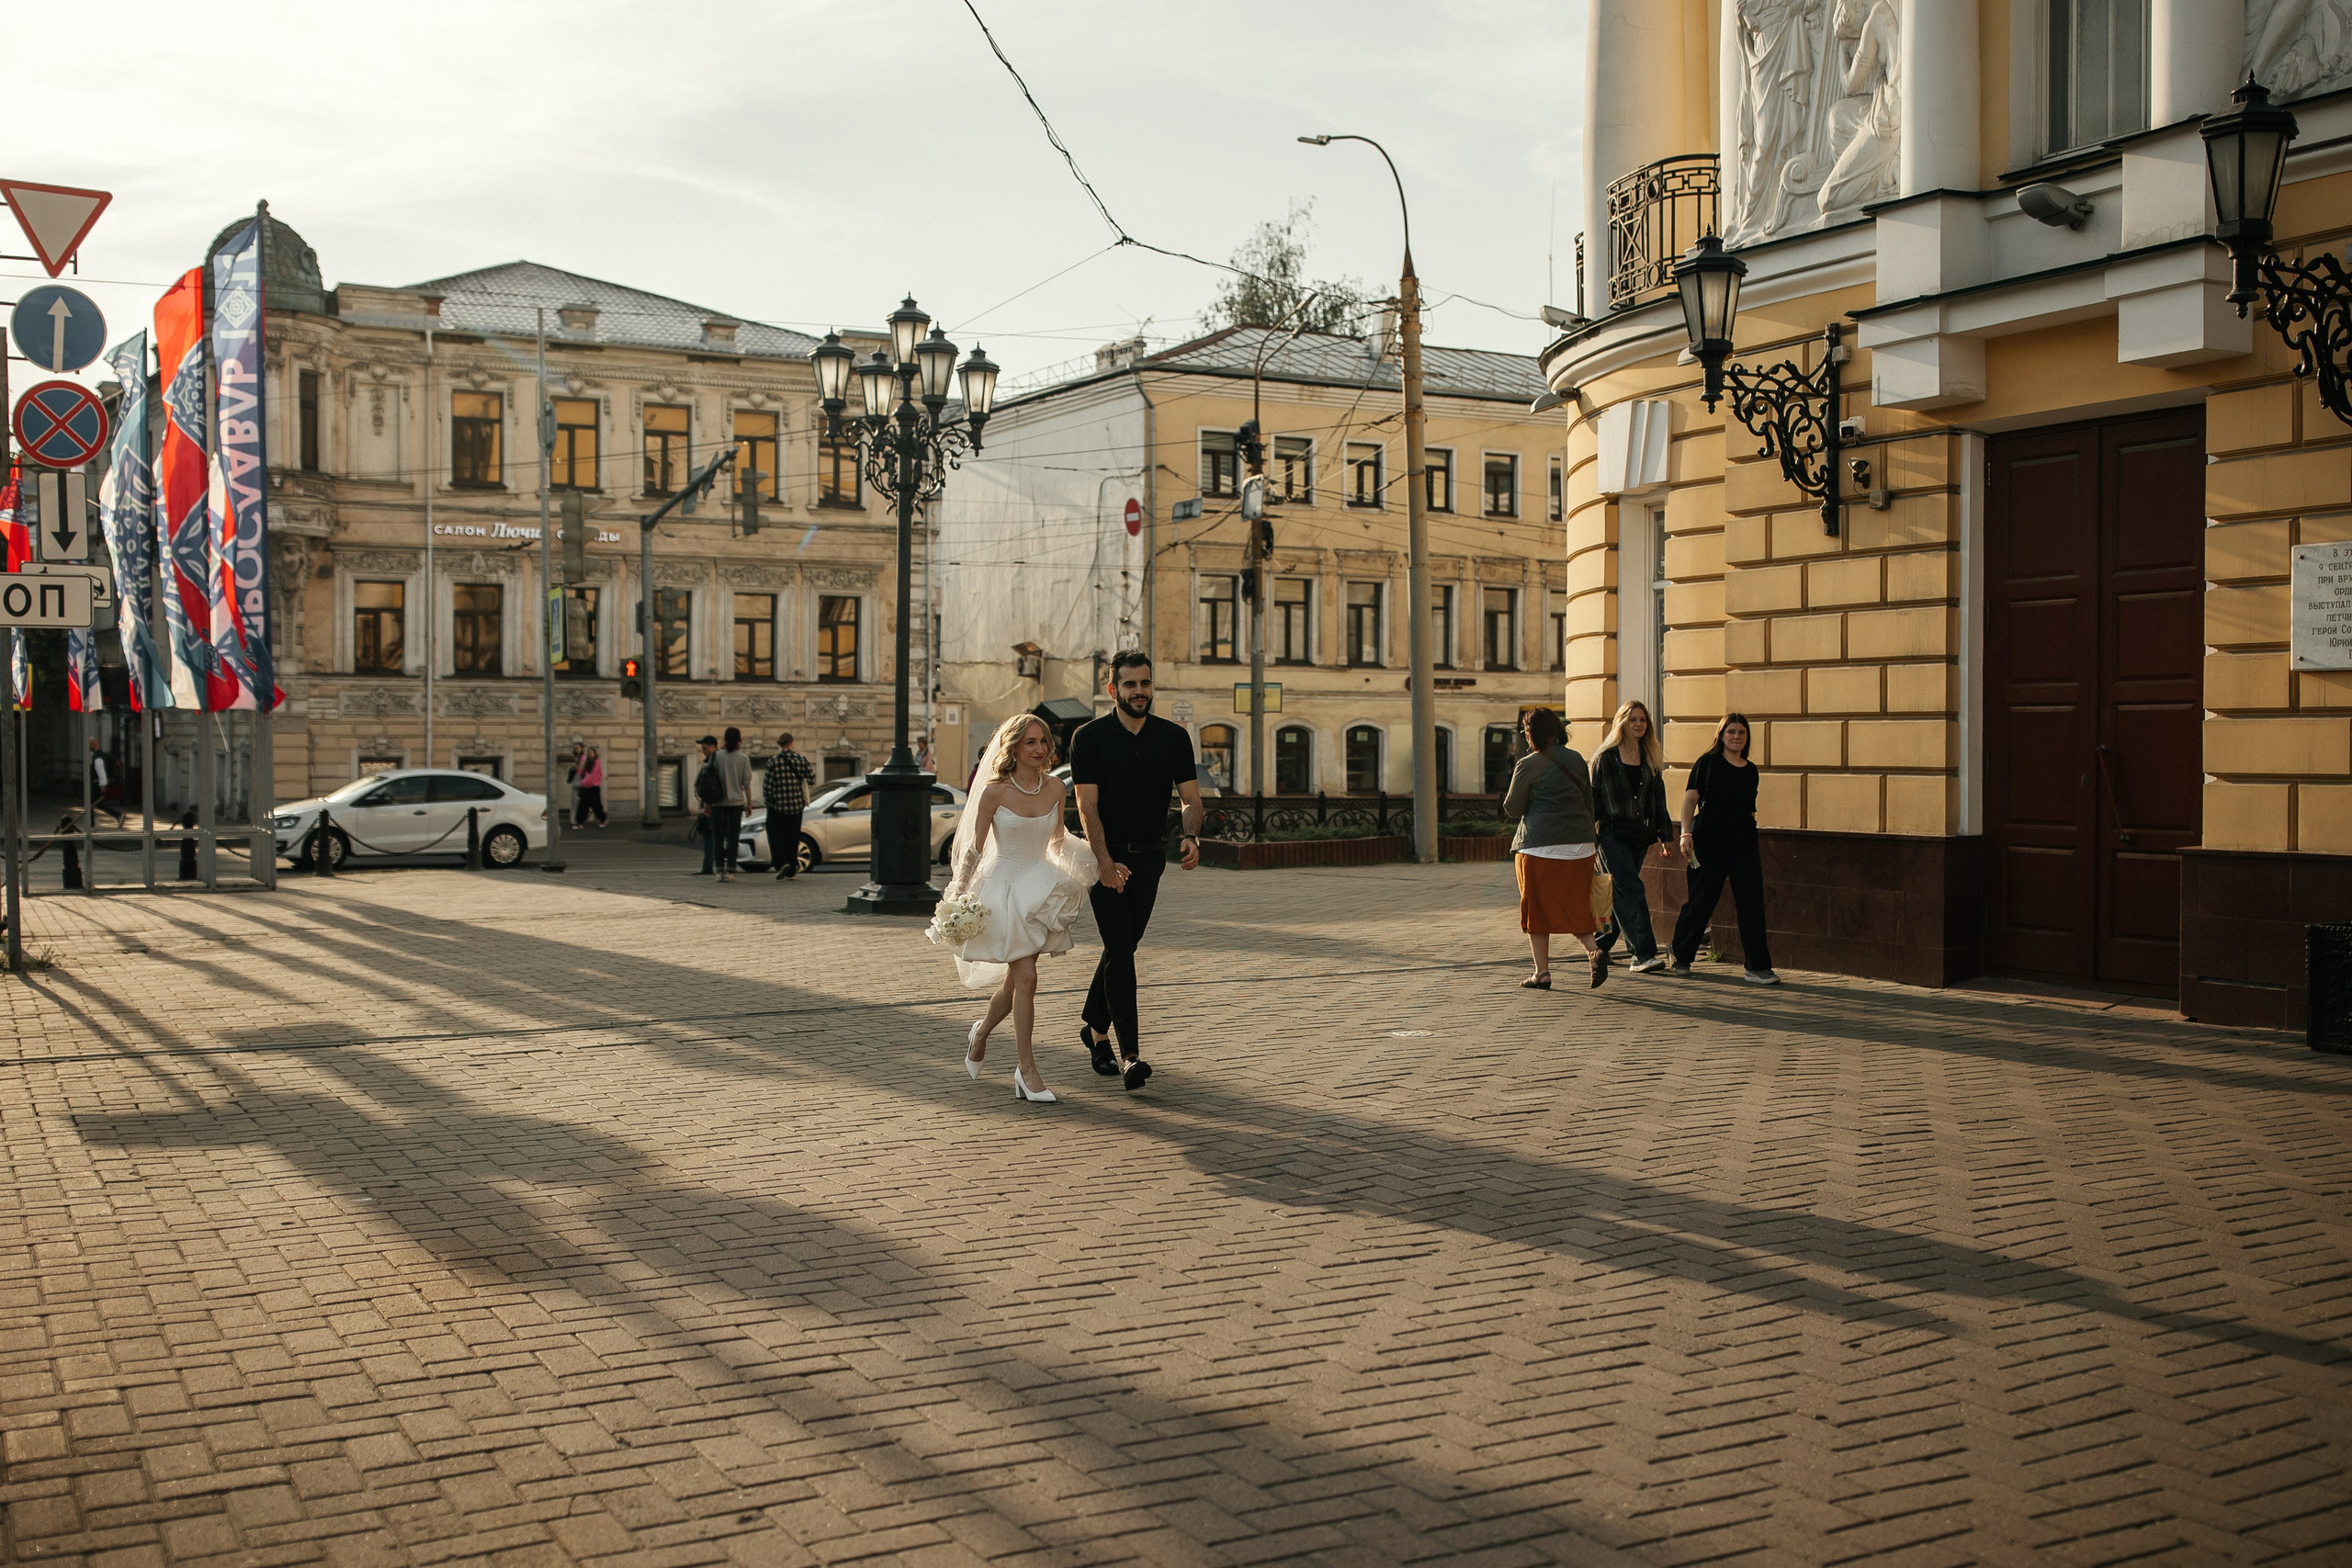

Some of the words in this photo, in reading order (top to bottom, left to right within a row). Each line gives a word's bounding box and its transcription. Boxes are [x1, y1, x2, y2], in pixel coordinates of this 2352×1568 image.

[490, 522, 542, 539] Лючи
[2333, 548, 2338, 558] В
[2318, 563, 2324, 571] 9
[2318, 575, 2334, 584] ПРИ
[2308, 600, 2351, 610] ВЫСТУПАЛ
[2312, 625, 2337, 635] ГЕРОЙ
